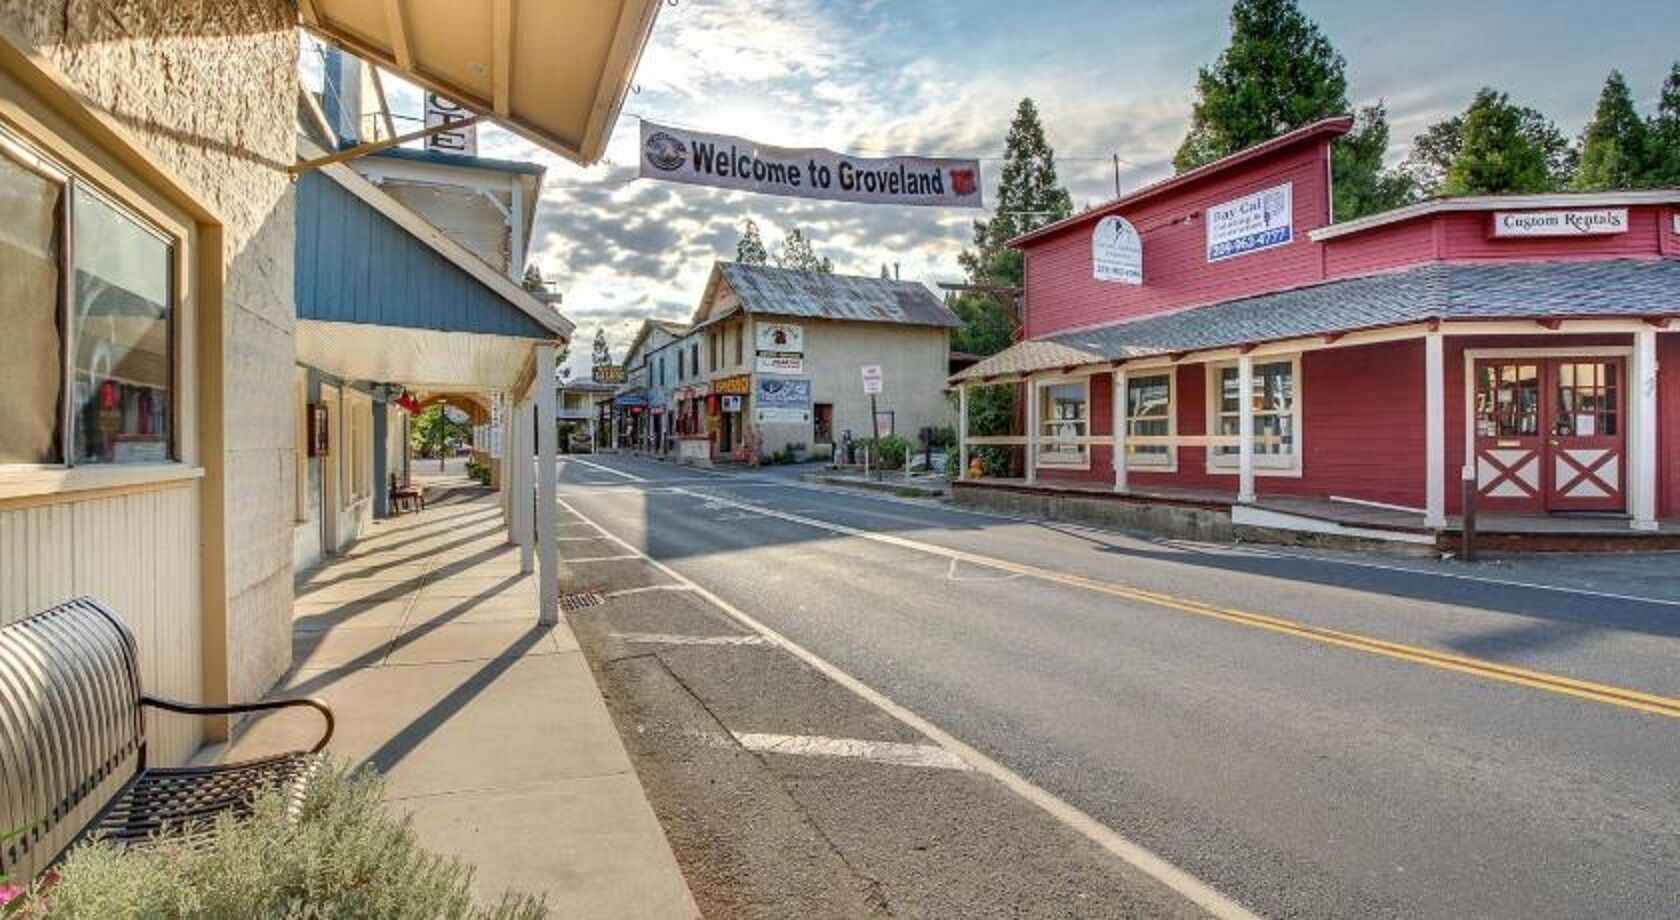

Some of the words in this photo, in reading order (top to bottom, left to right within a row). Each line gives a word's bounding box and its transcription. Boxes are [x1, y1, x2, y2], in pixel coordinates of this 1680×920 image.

[692, 141, 801, 187] Welcome
[808, 159, 831, 189] to
[838, 161, 945, 195] Groveland
[1503, 214, 1559, 230] Custom
[1565, 211, 1621, 232] Rentals
